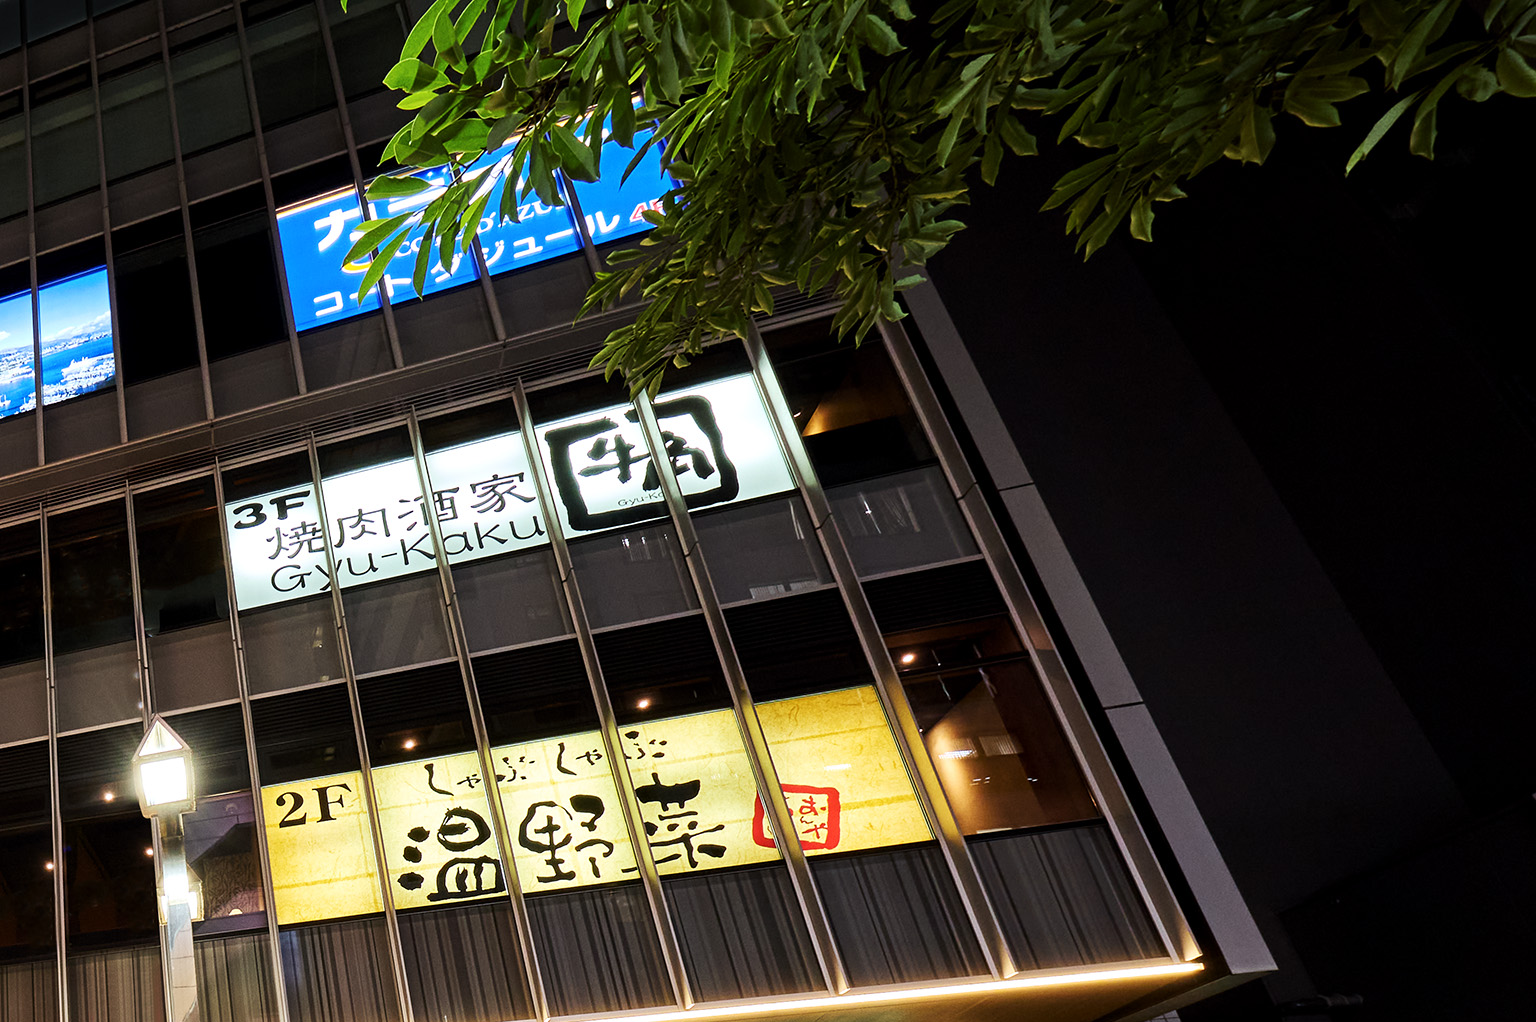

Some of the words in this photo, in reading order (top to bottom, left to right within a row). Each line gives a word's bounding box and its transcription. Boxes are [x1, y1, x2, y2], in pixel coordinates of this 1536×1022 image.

[578, 430, 715, 492] 牛角
[232, 490, 311, 529] 3F
[266, 472, 536, 561] 焼肉酒家
[270, 514, 547, 594] Gyu-Kaku
[275, 783, 351, 829] 2F
[398, 772, 727, 902] 温野菜
